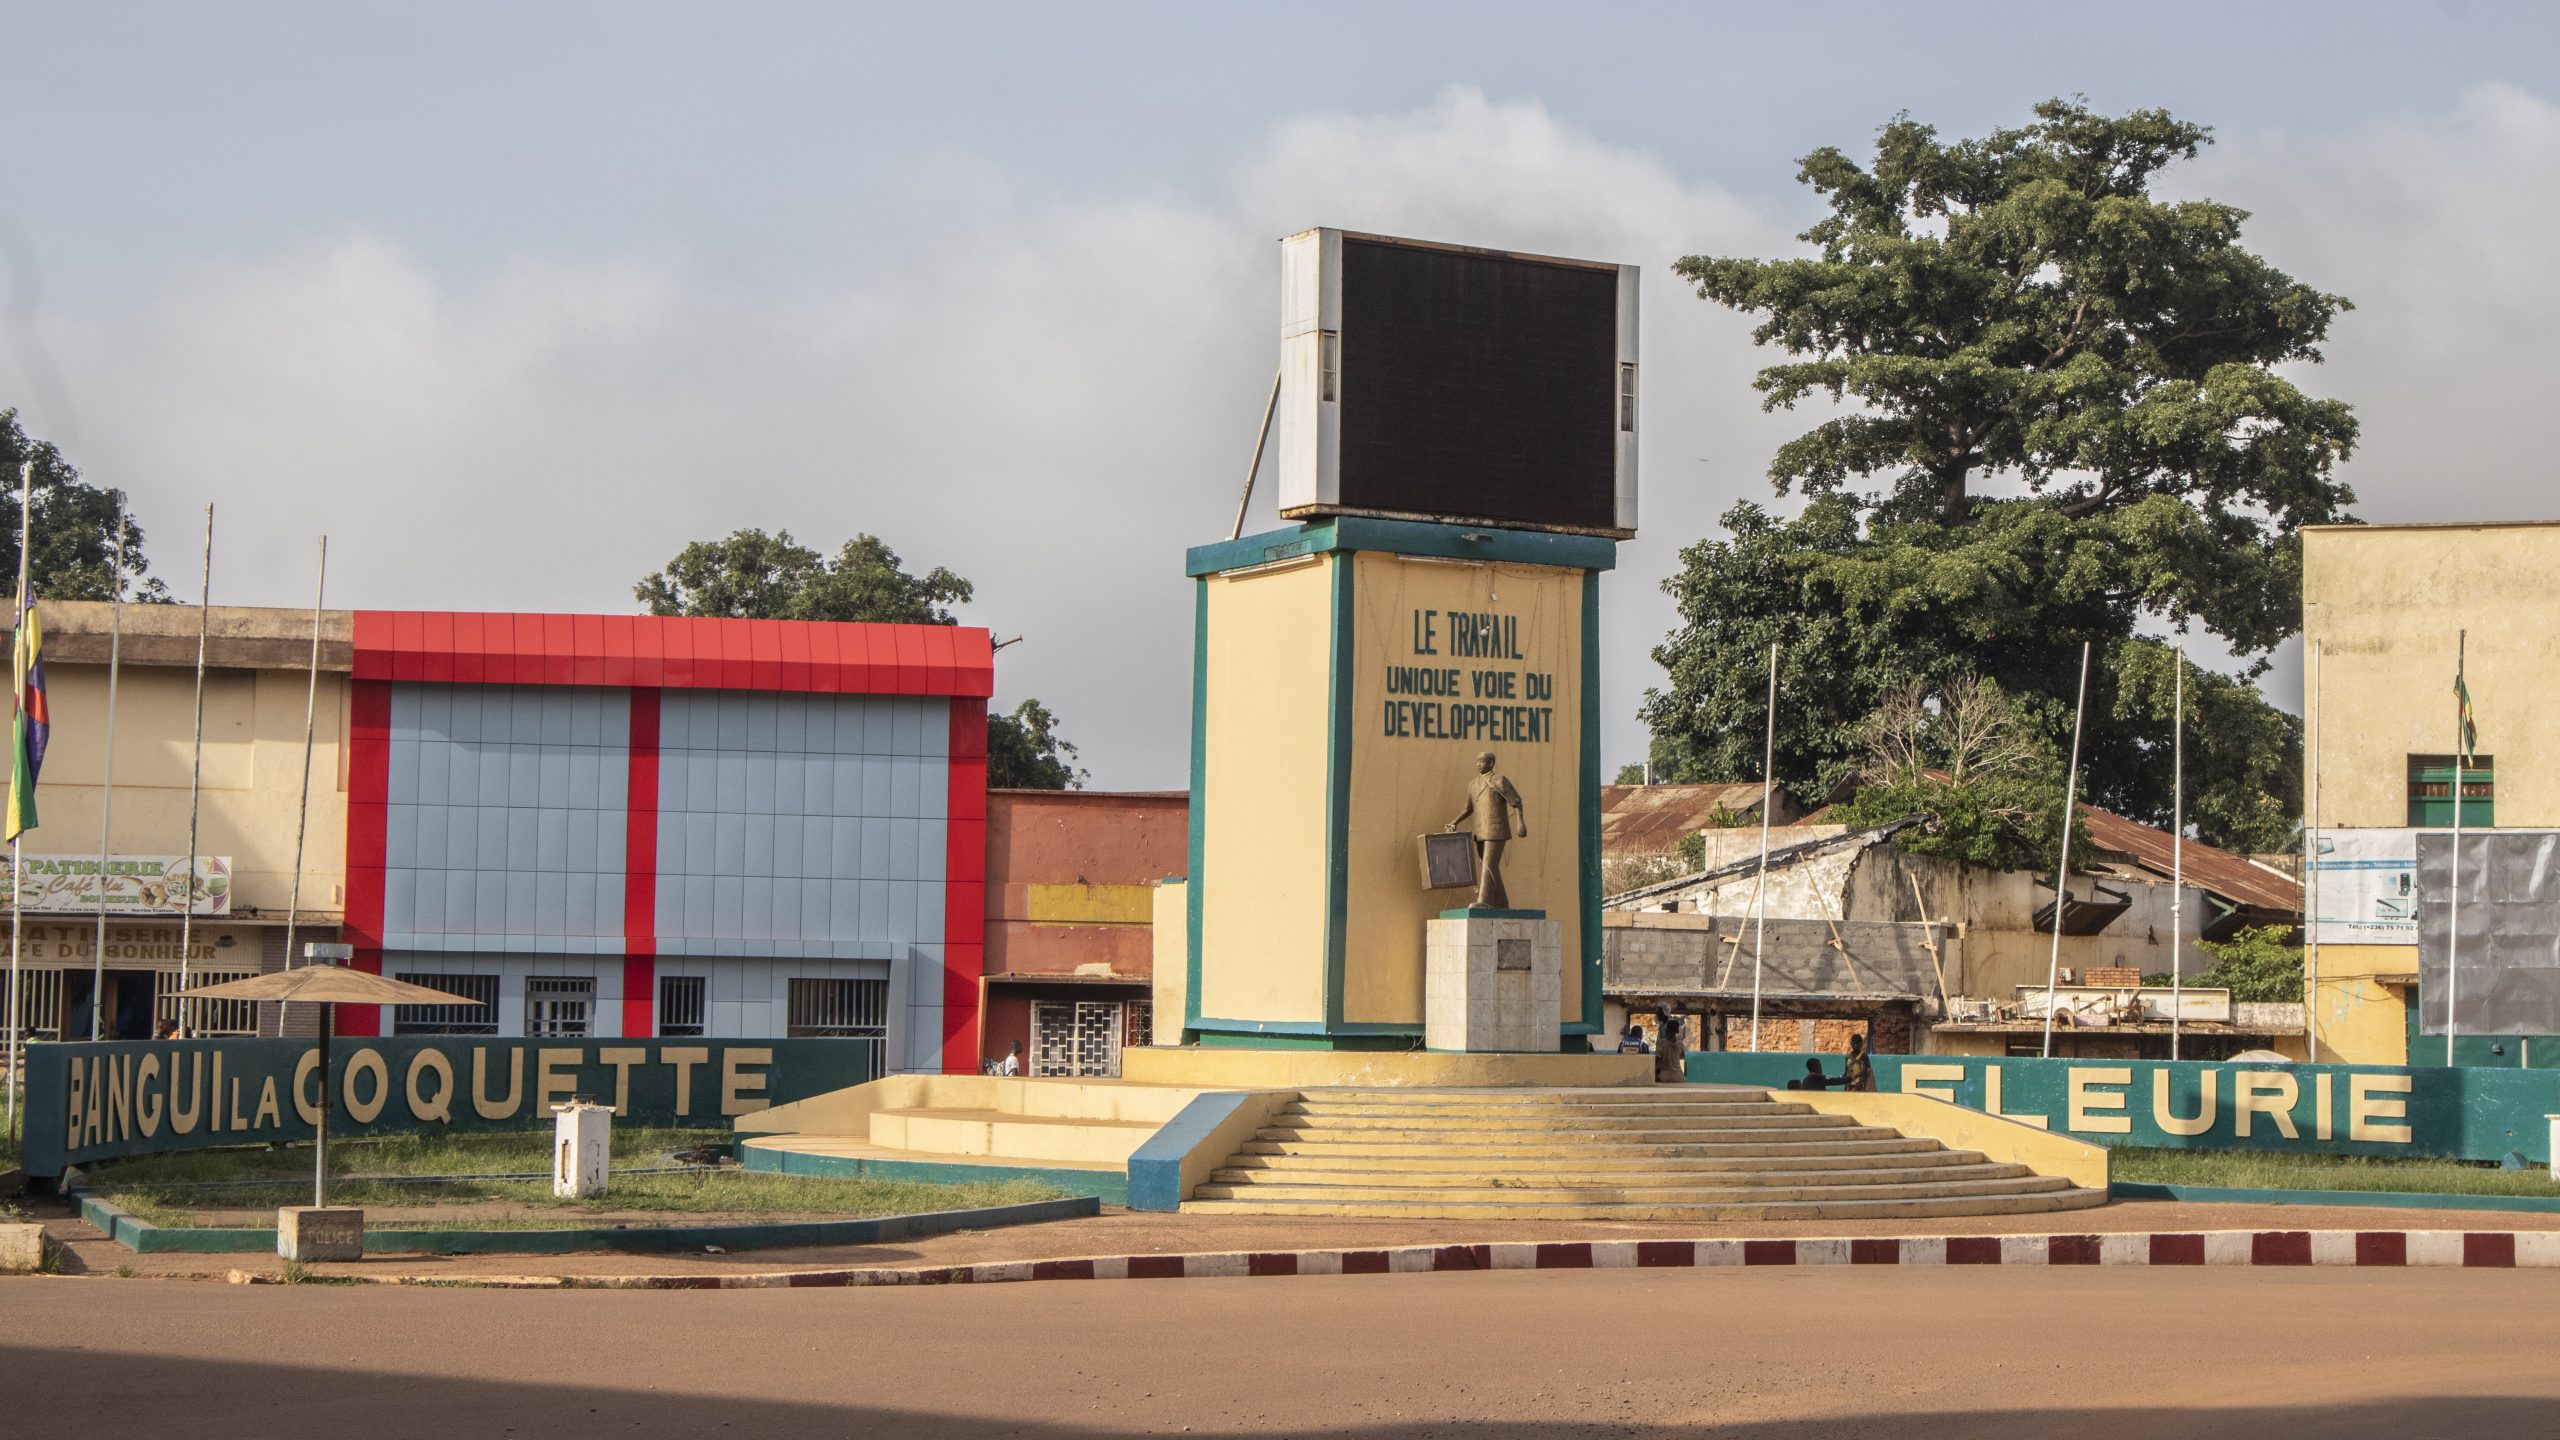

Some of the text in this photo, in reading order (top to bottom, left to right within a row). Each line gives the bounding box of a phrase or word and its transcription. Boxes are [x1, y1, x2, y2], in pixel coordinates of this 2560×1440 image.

[1414, 609, 1523, 660] LE TRAVAIL
[1386, 666, 1552, 700] UNIQUE VOIE DU
[1384, 700, 1553, 742] DEVELOPPEMENT
[29, 859, 164, 877] PATISSERIE
[47, 875, 95, 896] Café
[58, 944, 89, 958] DU
[105, 944, 215, 959] BONHEUR
[67, 1047, 773, 1150] BANGUI LA COQUETTE
[1901, 1063, 2412, 1144] FLEURIE
